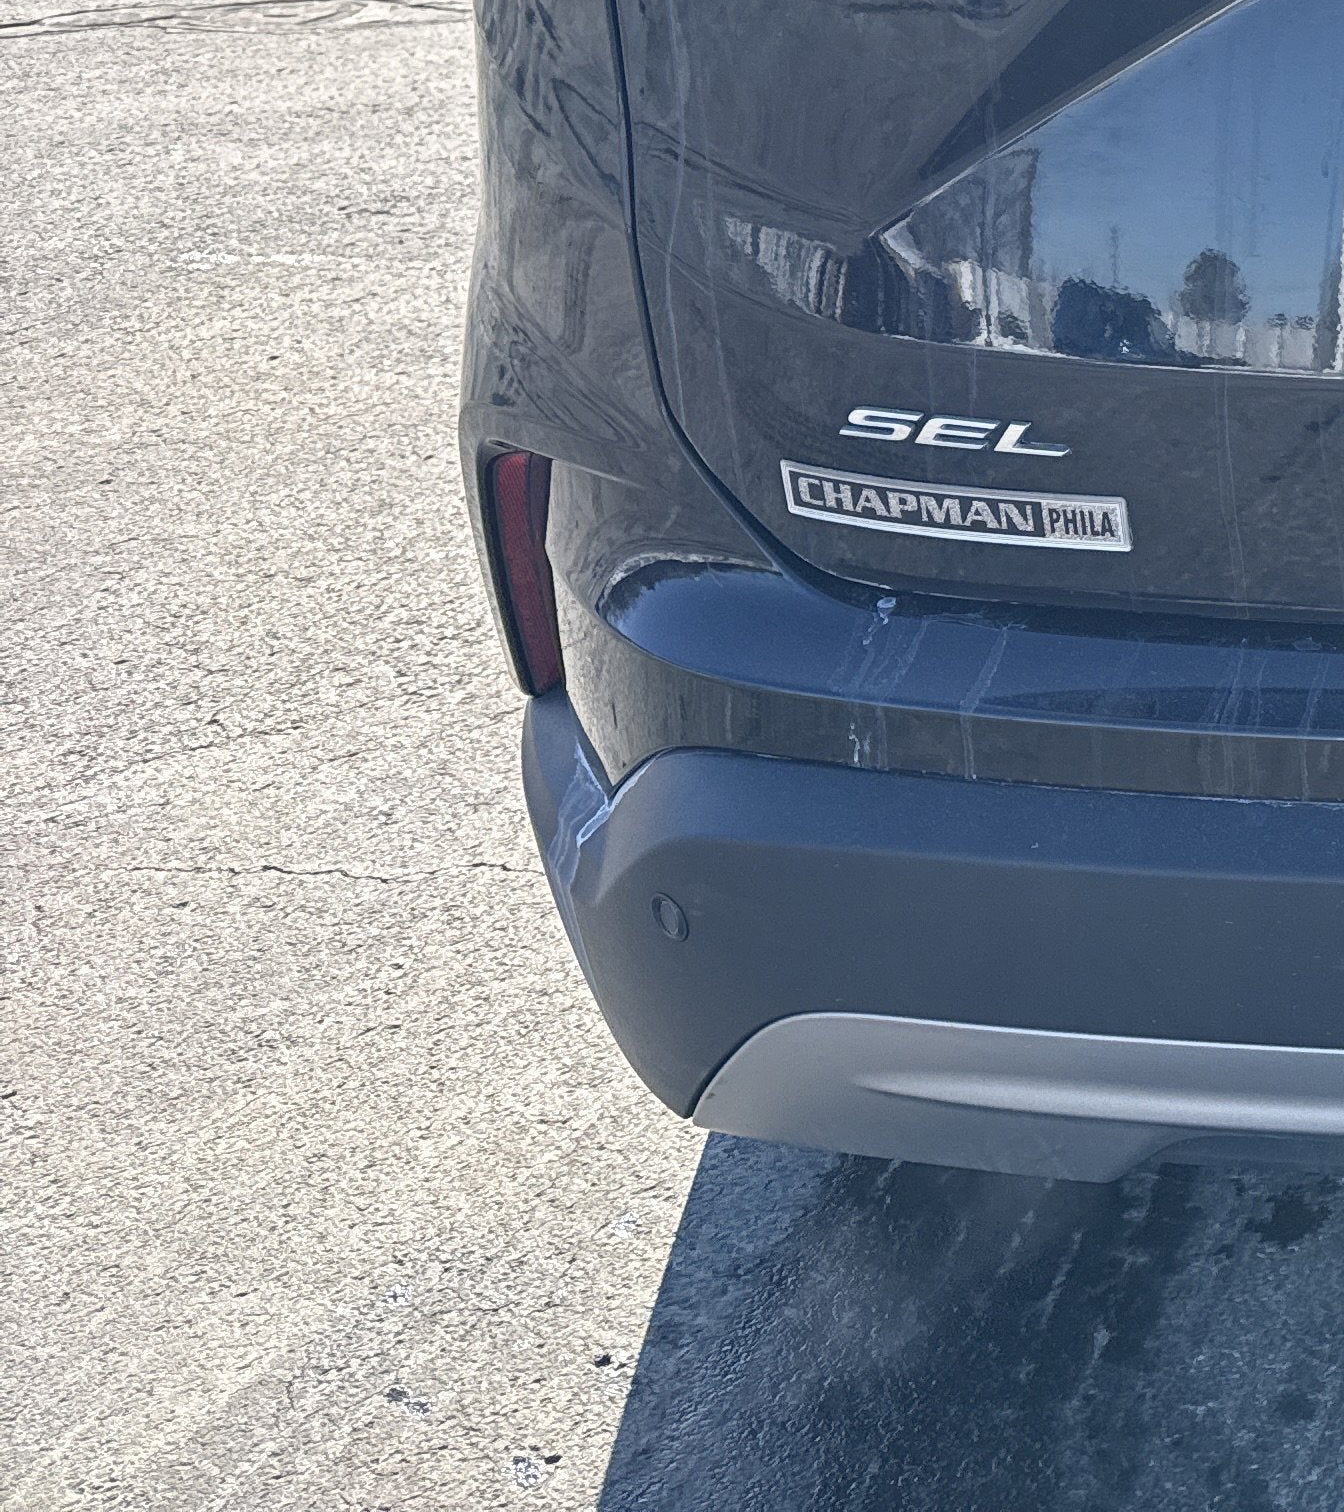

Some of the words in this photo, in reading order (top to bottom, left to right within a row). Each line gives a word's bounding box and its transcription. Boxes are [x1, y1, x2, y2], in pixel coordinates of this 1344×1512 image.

[839, 406, 1072, 457] SEL
[798, 477, 1036, 532] CHAPMAN
[1049, 507, 1116, 539] PHILA
